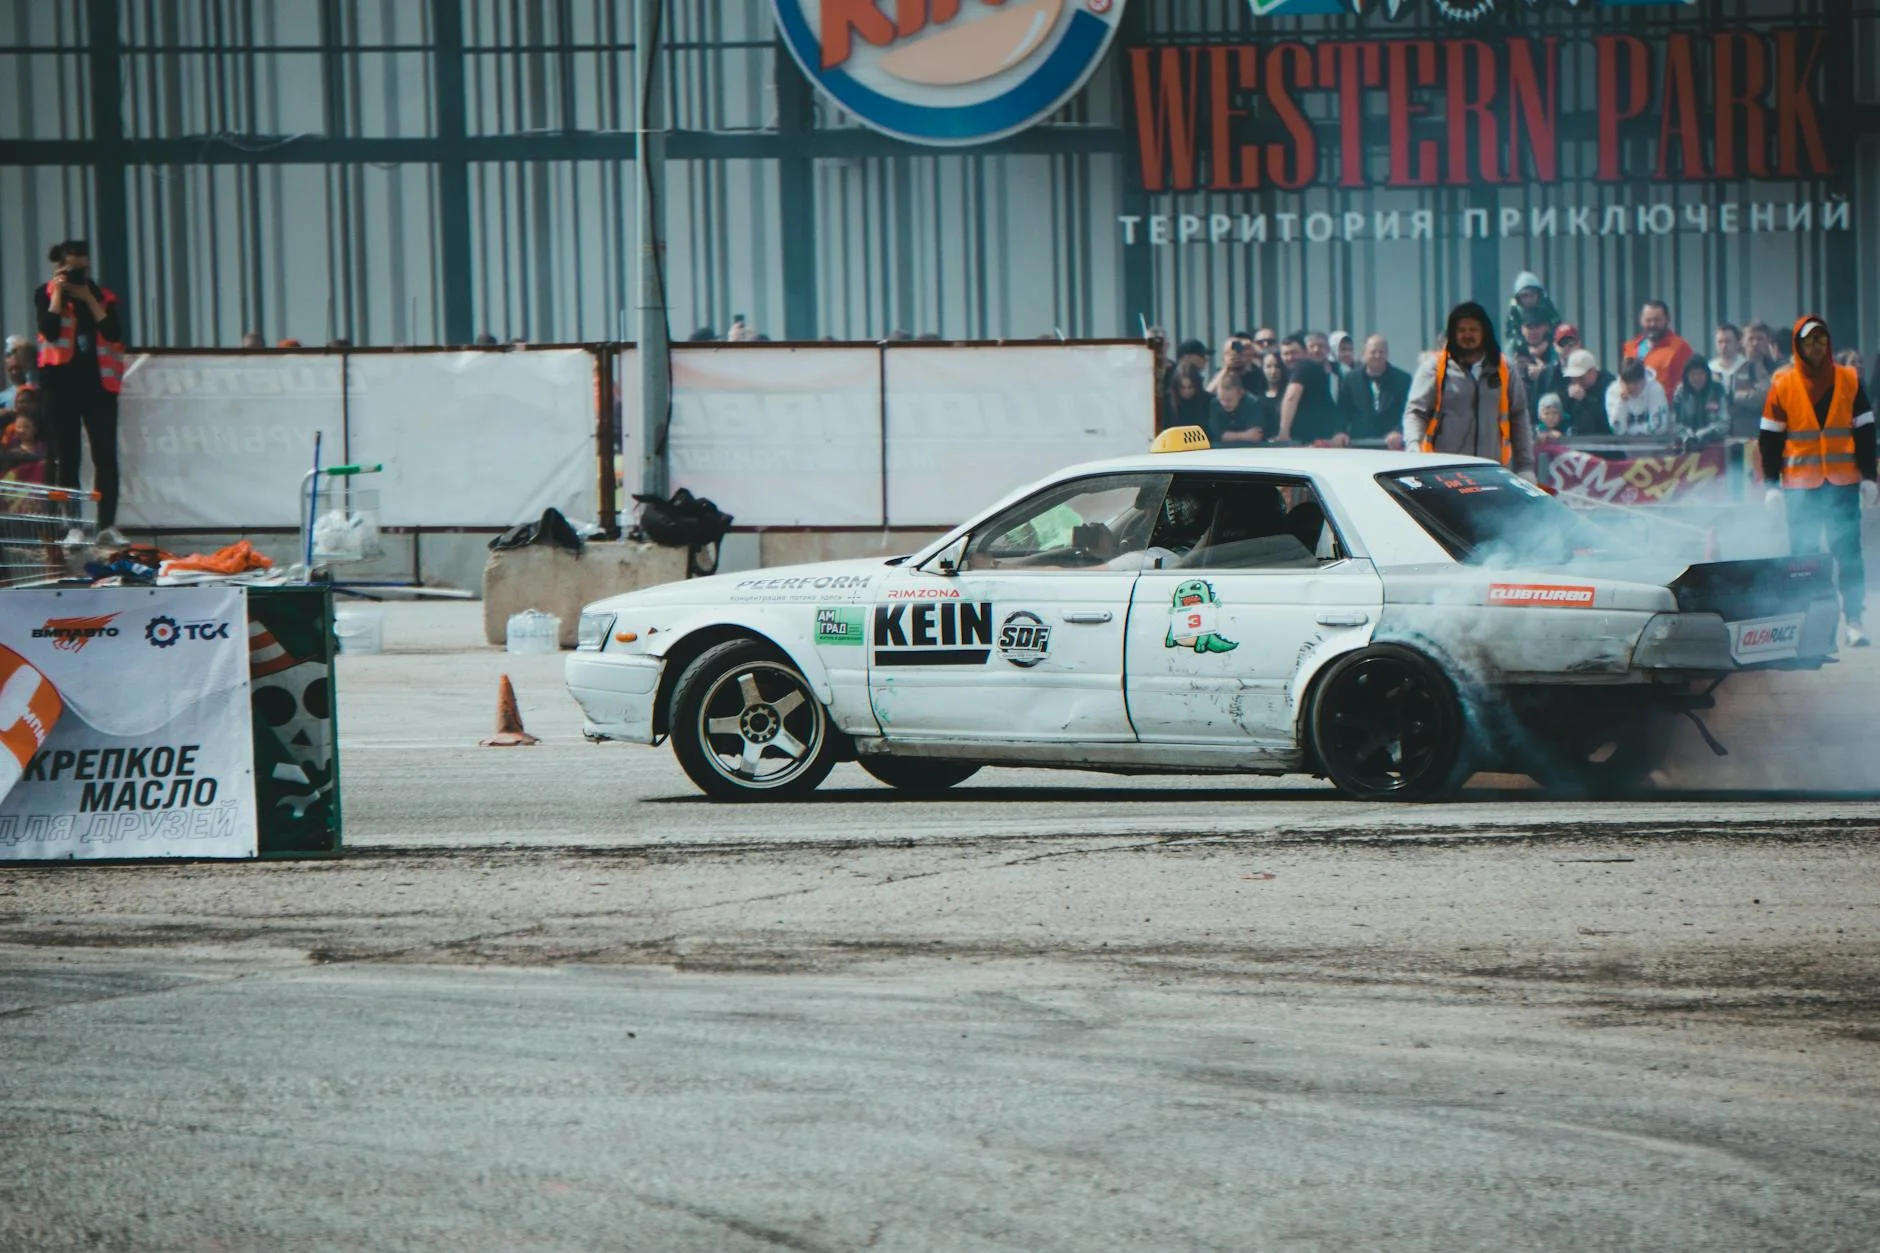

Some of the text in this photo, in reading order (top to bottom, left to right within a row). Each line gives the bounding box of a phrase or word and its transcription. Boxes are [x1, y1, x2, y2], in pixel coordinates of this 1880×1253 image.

[1127, 35, 1559, 191] WESTERN
[1595, 29, 1830, 182] PARK
[1118, 194, 1851, 245] ТЕРРИТОРИЯ ПРИКЛЮЧЕНИЙ
[735, 574, 873, 590] PEERFORM
[887, 589, 961, 599] RIMZONA
[1488, 586, 1593, 602] CLUBTURBO
[183, 622, 230, 641] ТСК
[821, 623, 847, 634] ГРАД
[873, 602, 993, 646] KEIN
[1187, 614, 1202, 629] 3
[999, 626, 1050, 649] SDF
[22, 745, 200, 781] КРЕПКОЕ
[79, 777, 218, 813] МАСЛО
[0, 799, 239, 846] ДЛЯ ДРУЗЕЙ
